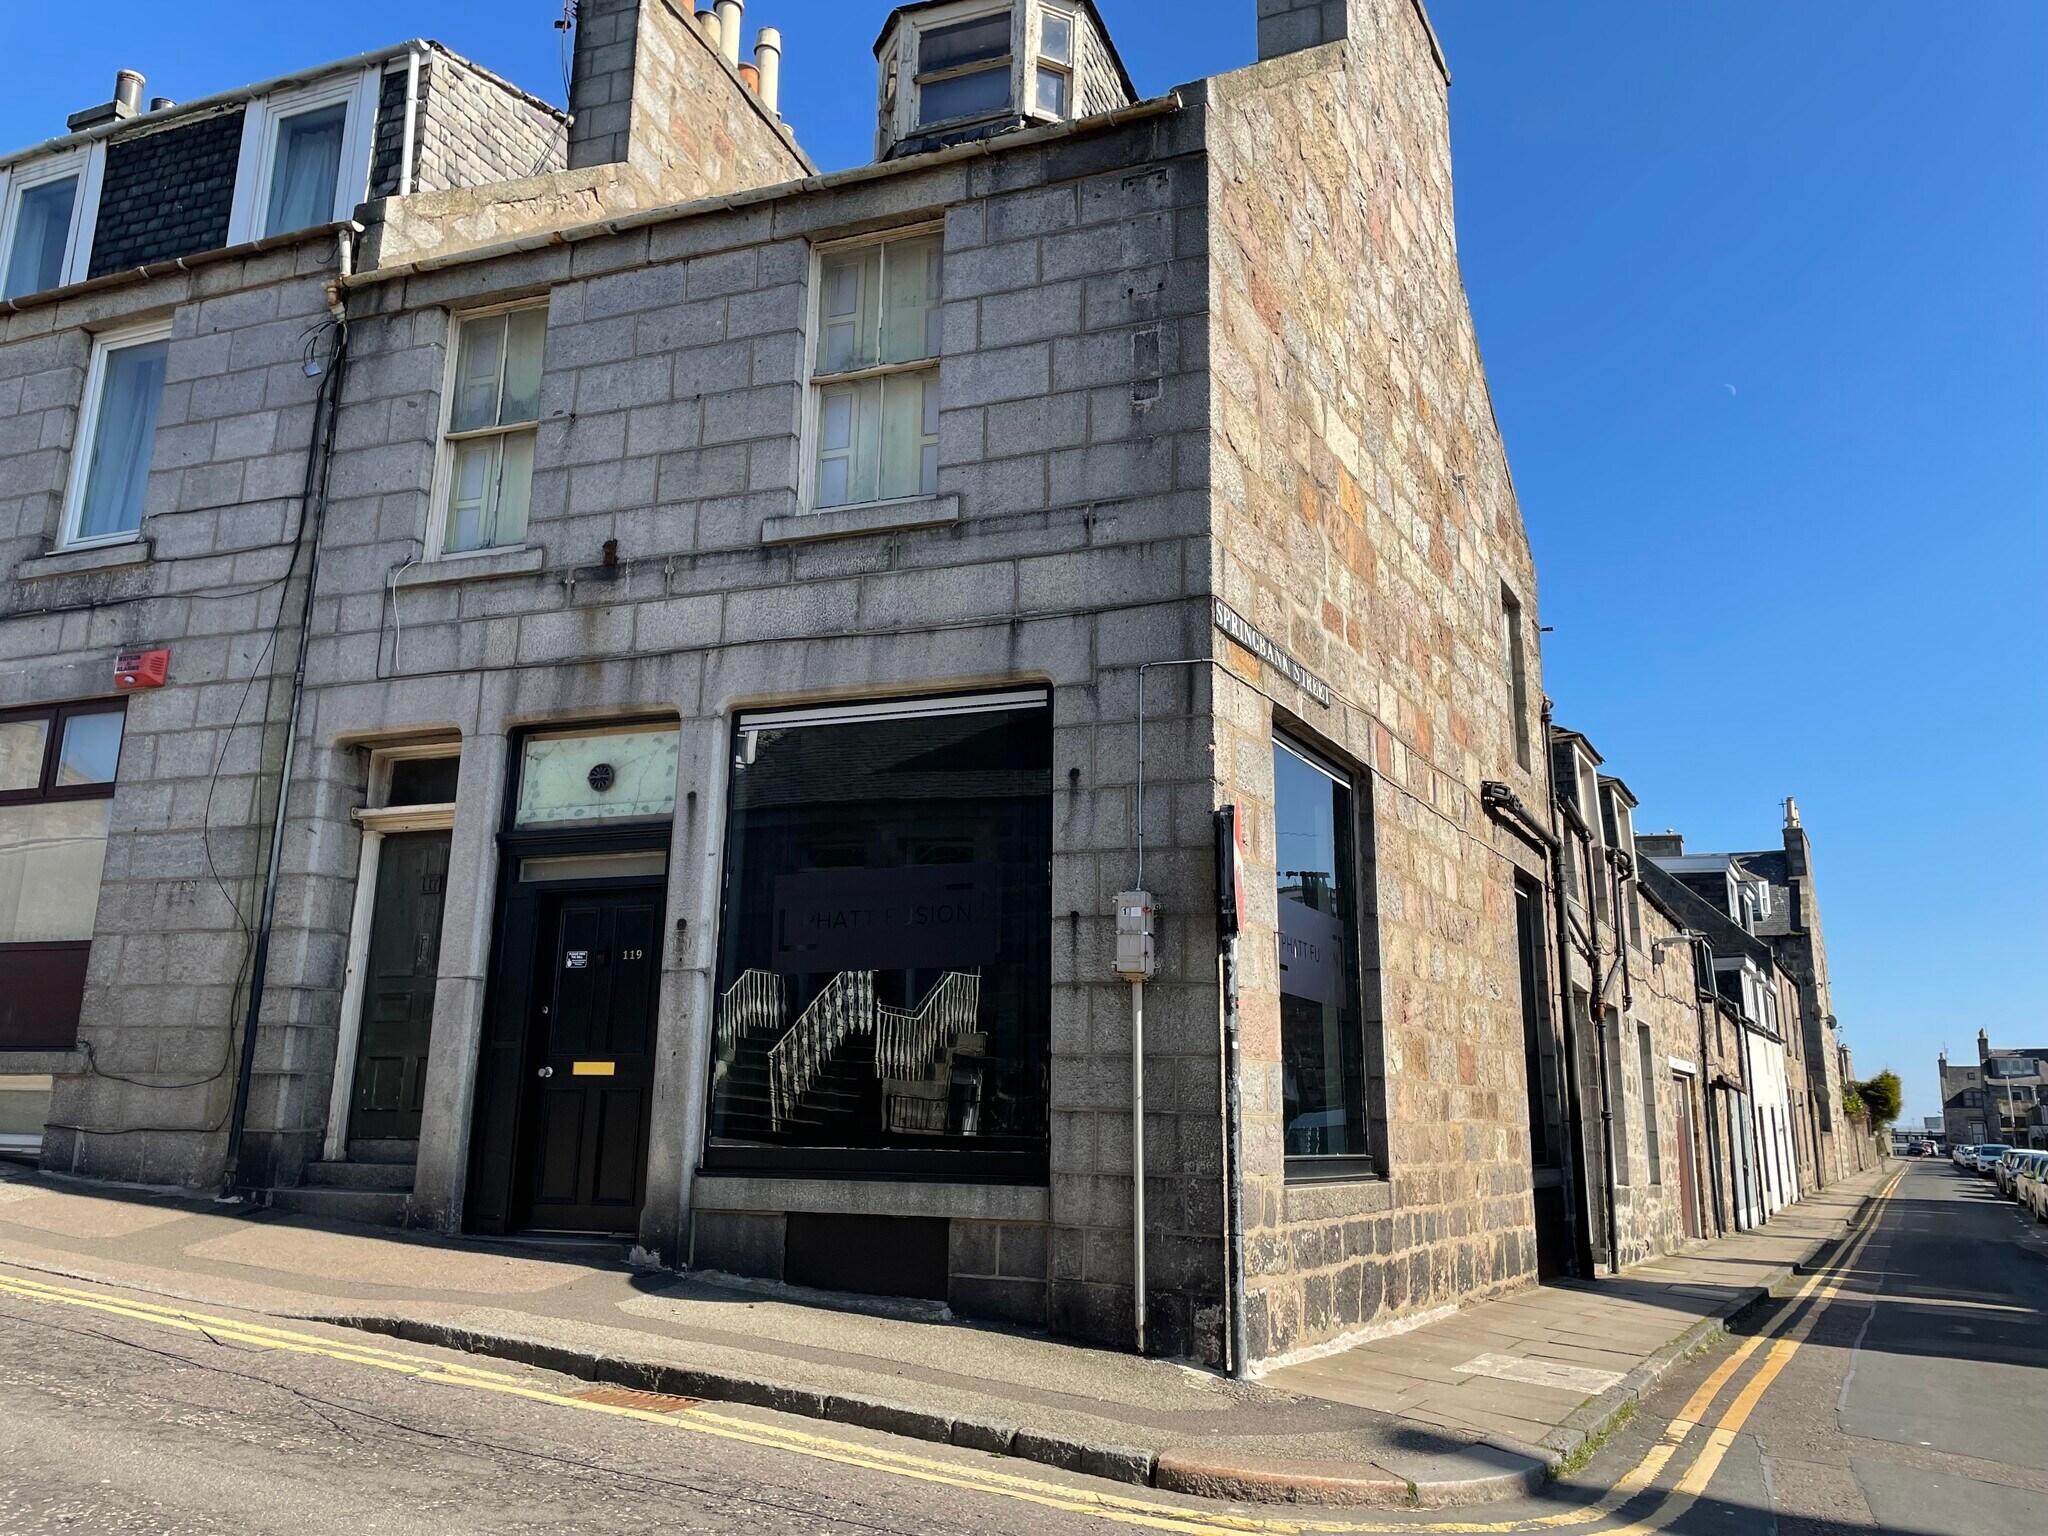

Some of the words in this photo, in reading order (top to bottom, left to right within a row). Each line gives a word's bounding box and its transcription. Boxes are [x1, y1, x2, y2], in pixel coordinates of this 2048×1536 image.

[1215, 601, 1291, 676] SPRINGBANK
[1293, 664, 1330, 705] STREET
[622, 949, 643, 960] 119
[1281, 935, 1308, 959] PHATT
